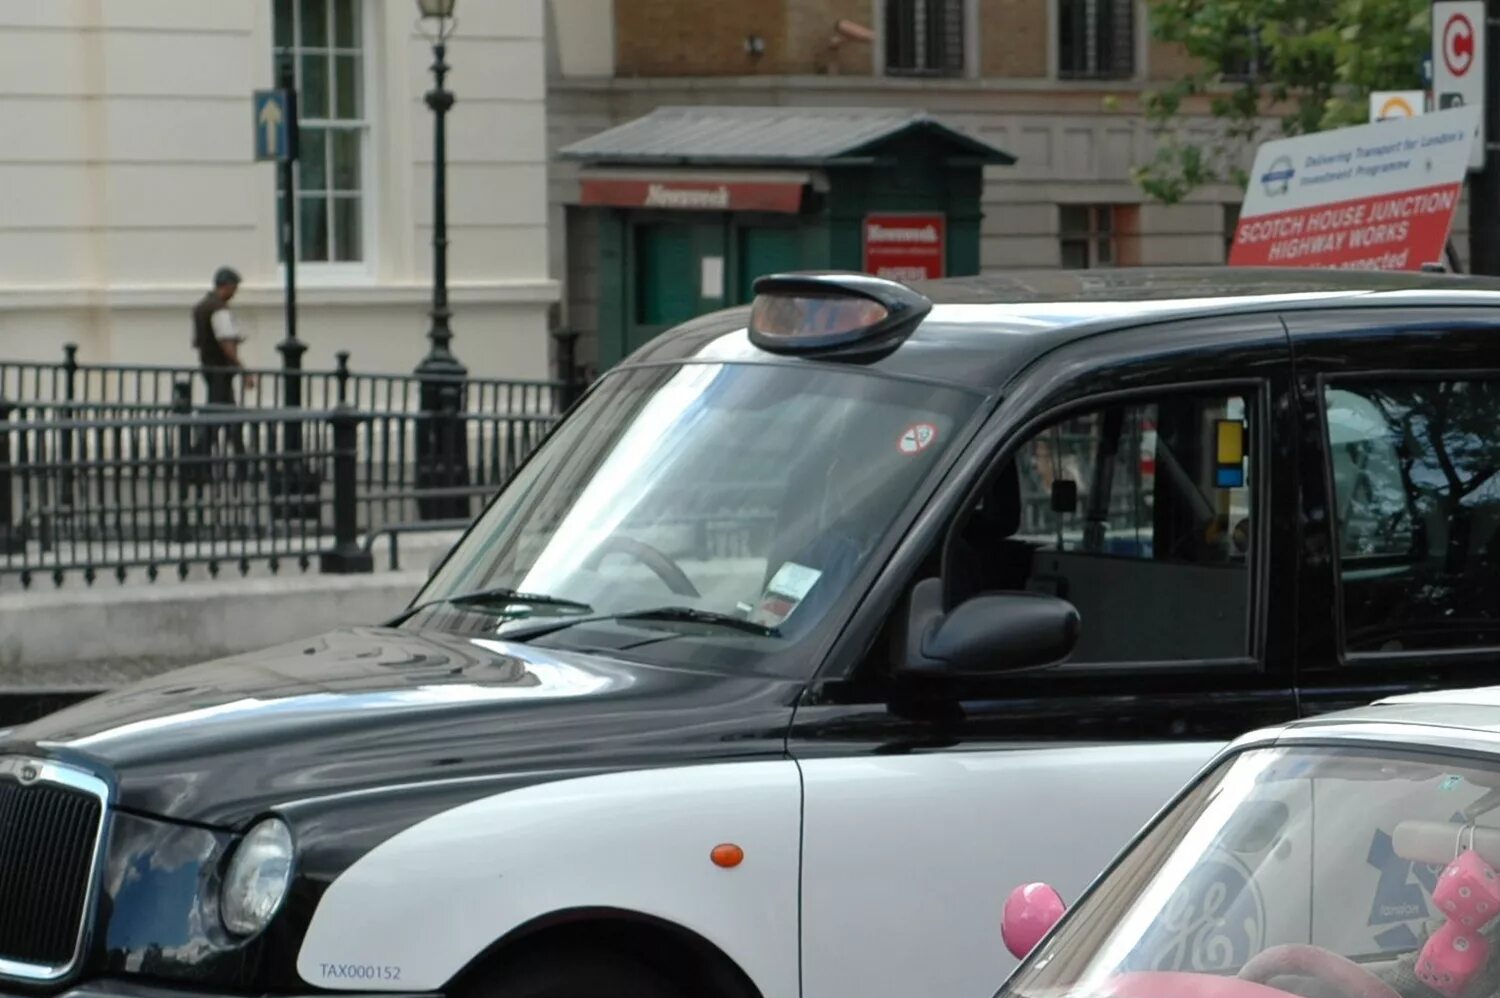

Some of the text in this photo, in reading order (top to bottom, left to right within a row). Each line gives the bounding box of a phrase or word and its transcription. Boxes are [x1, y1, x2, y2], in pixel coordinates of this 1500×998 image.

[1305, 130, 1464, 167] Delivering Transport for London's
[1302, 169, 1352, 186] Investment
[1355, 160, 1411, 178] Programme
[1239, 190, 1457, 244] SCOTCH HOUSE JUNCTION
[1268, 221, 1410, 262] HIGHWAY WORKS
[320, 963, 401, 980] TAX000152
